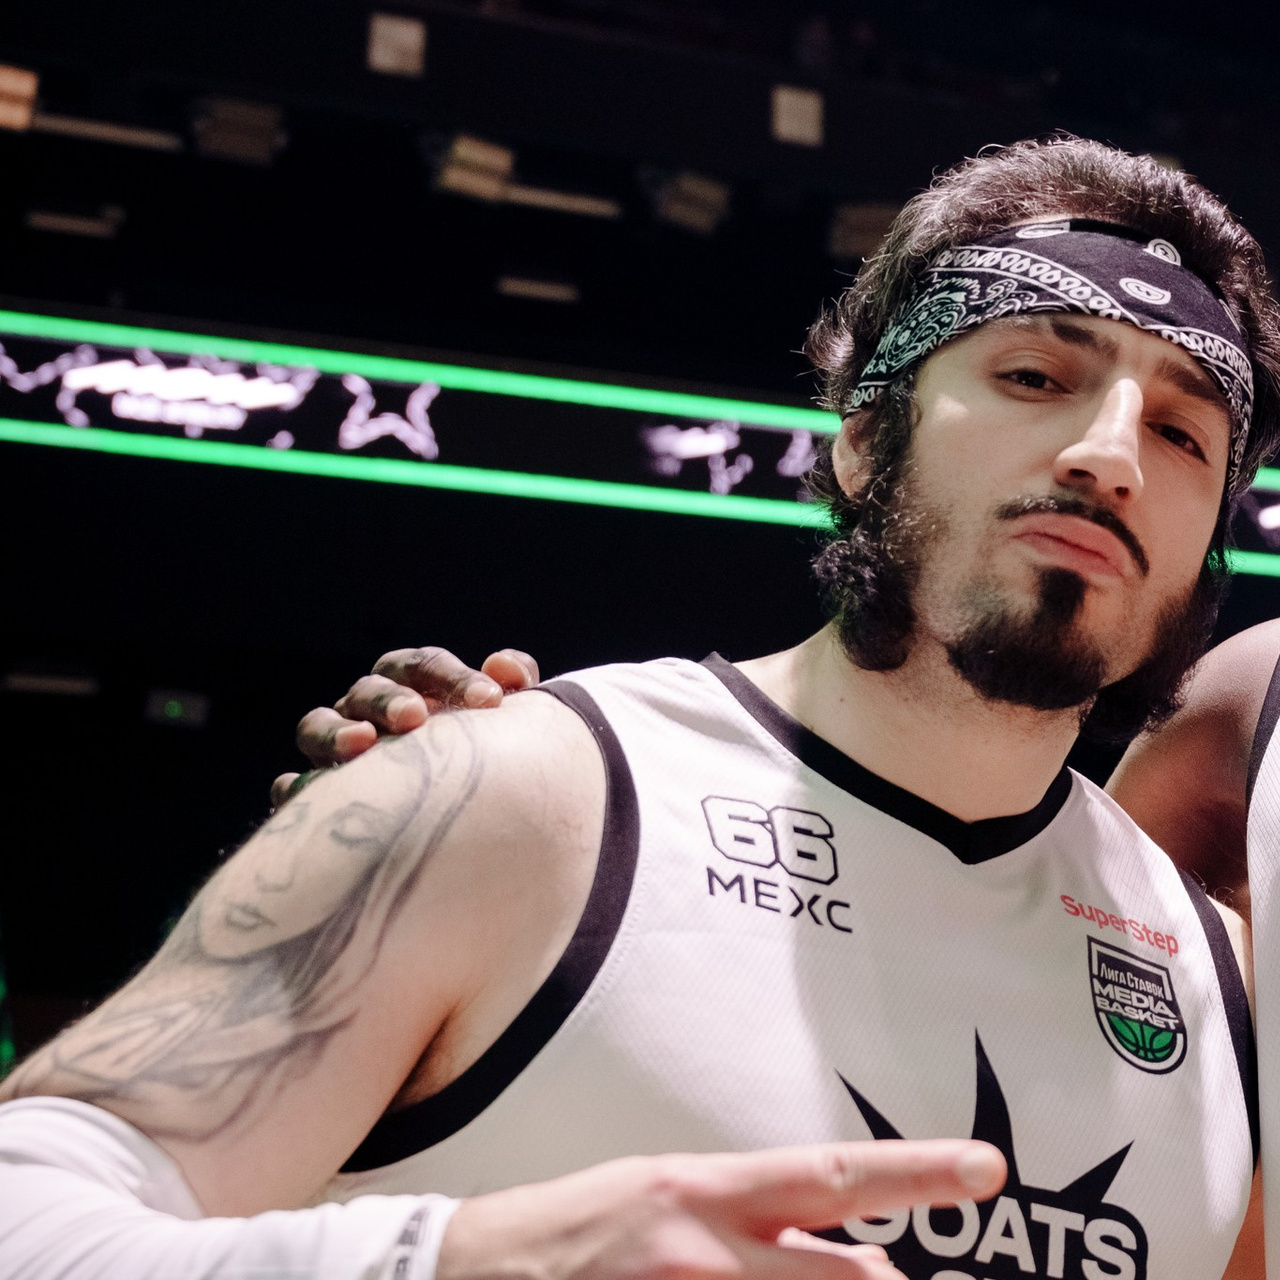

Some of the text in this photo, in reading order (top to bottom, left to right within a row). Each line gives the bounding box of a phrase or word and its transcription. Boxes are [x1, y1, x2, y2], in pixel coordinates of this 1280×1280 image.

[701, 794, 839, 886] 66
[706, 866, 853, 933] MEXC
[1060, 894, 1179, 958] SuperStep
[1092, 978, 1177, 1018] MEDIA
[1095, 995, 1179, 1030] BASKET
